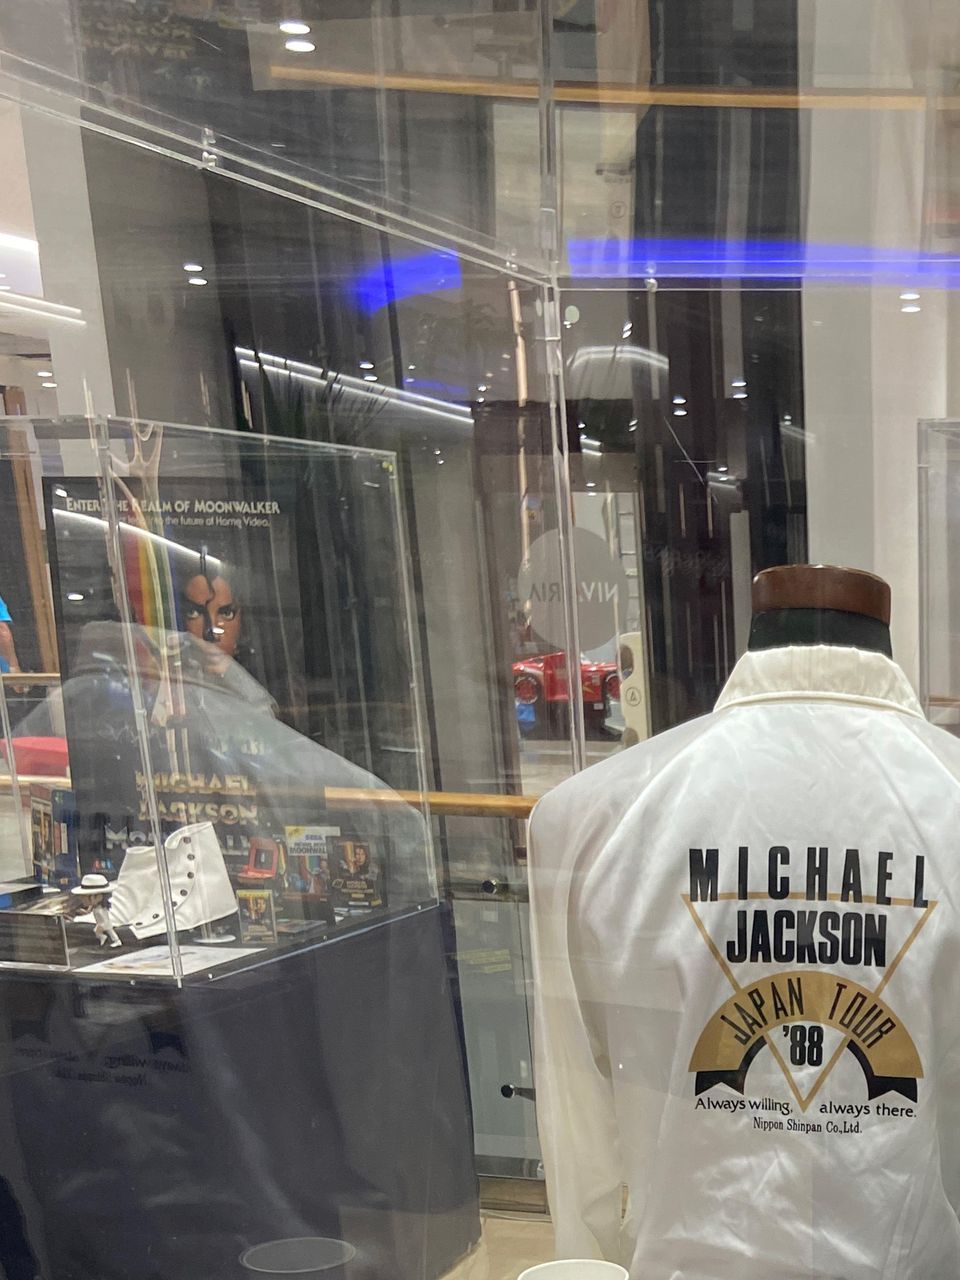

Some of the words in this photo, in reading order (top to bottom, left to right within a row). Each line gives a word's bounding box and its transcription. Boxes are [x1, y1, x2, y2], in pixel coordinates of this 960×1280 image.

[66, 498, 100, 511] ENTER
[174, 500, 190, 512] OF
[194, 500, 280, 514] MOONWALKER
[689, 846, 928, 907] MICHAEL
[726, 910, 887, 967] JACKSON
[720, 977, 804, 1045] JAPAN
[828, 983, 896, 1048] TOUR
[782, 1025, 824, 1066] '88
[695, 1097, 746, 1113] Always
[749, 1098, 793, 1115] willing,
[819, 1101, 870, 1116] always
[876, 1103, 917, 1118] there.
[753, 1117, 783, 1131] Nippon
[787, 1119, 822, 1134] Shinpan
